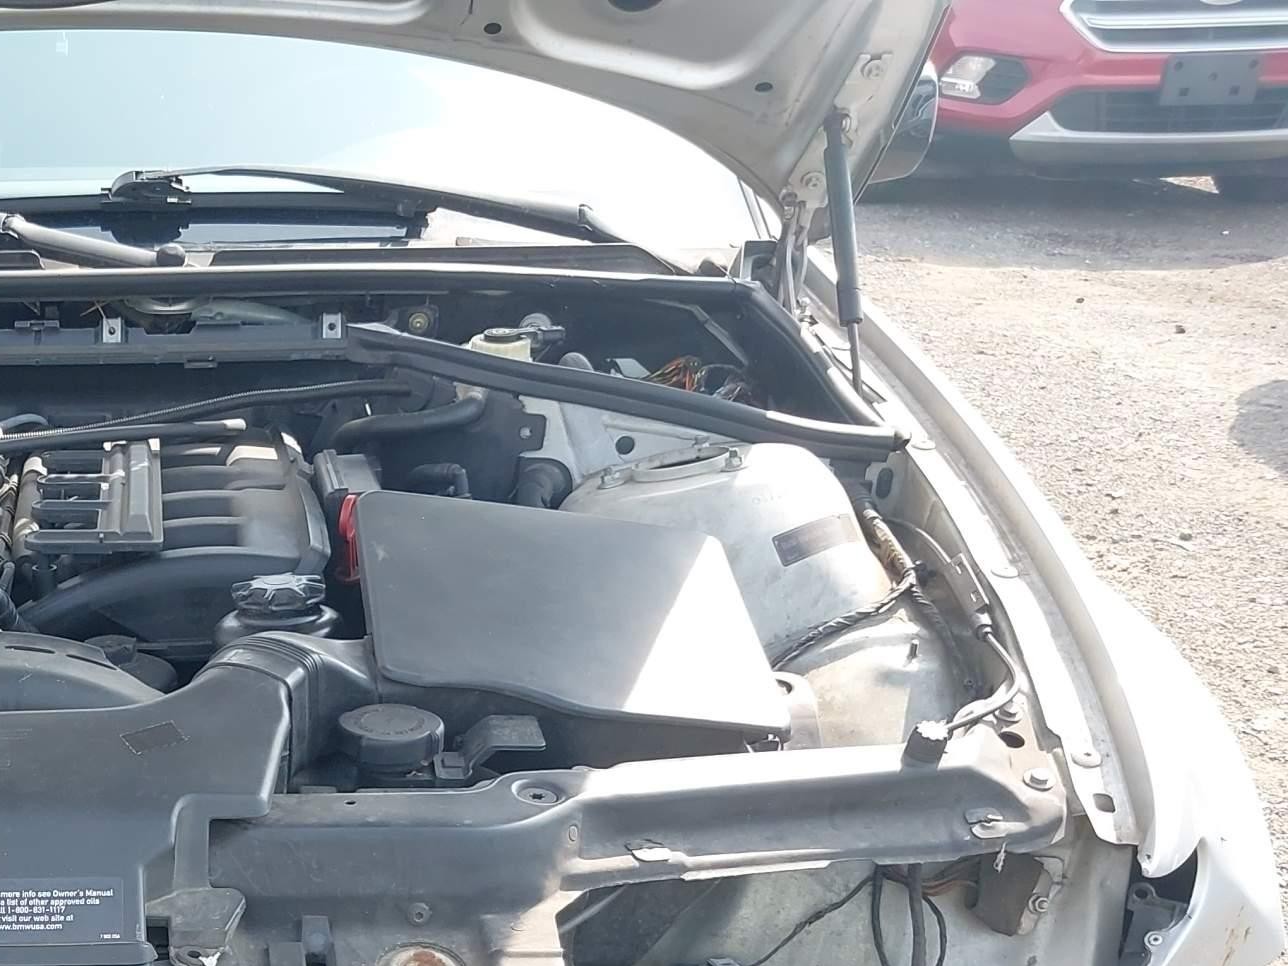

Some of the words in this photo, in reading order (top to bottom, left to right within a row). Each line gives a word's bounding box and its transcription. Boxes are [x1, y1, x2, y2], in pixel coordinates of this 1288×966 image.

[0, 890, 21, 898] more
[22, 889, 36, 898] info
[52, 889, 84, 897] Owner's
[85, 888, 113, 897] Manual
[6, 898, 18, 906] list
[19, 898, 28, 906] of
[28, 898, 49, 906] other
[50, 897, 85, 907] approved
[1, 914, 18, 922] visit
[33, 914, 49, 922] web
